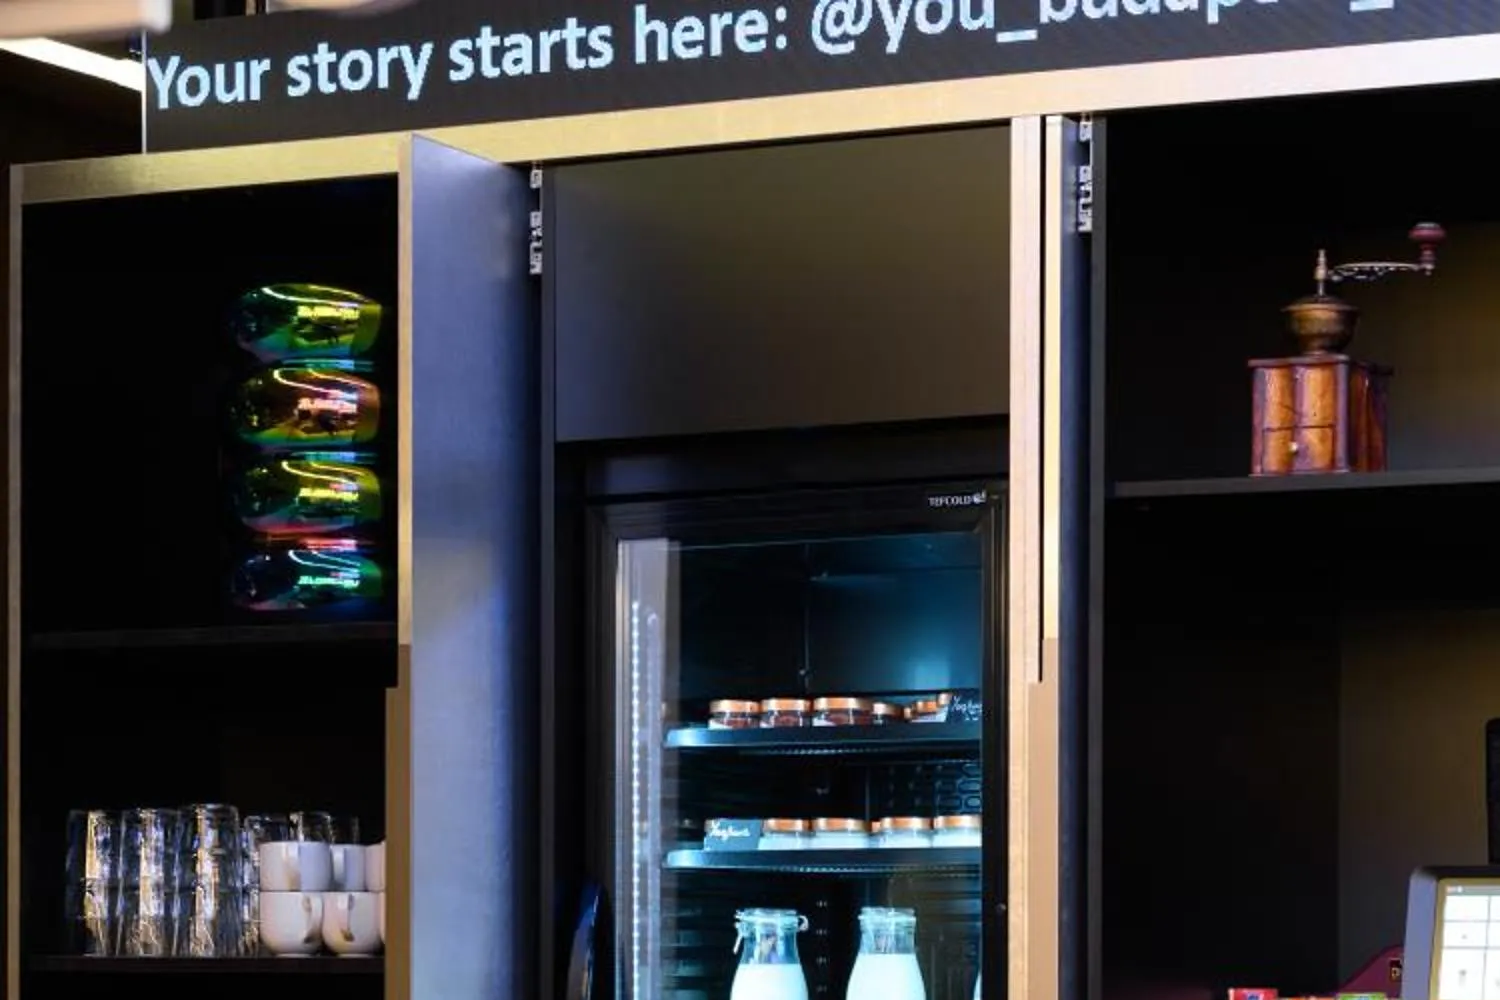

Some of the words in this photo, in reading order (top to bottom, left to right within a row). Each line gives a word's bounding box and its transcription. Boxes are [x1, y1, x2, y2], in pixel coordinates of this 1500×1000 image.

[147, 55, 271, 110] Your
[287, 42, 434, 101] story
[449, 16, 615, 82] starts
[634, 3, 788, 64] here:
